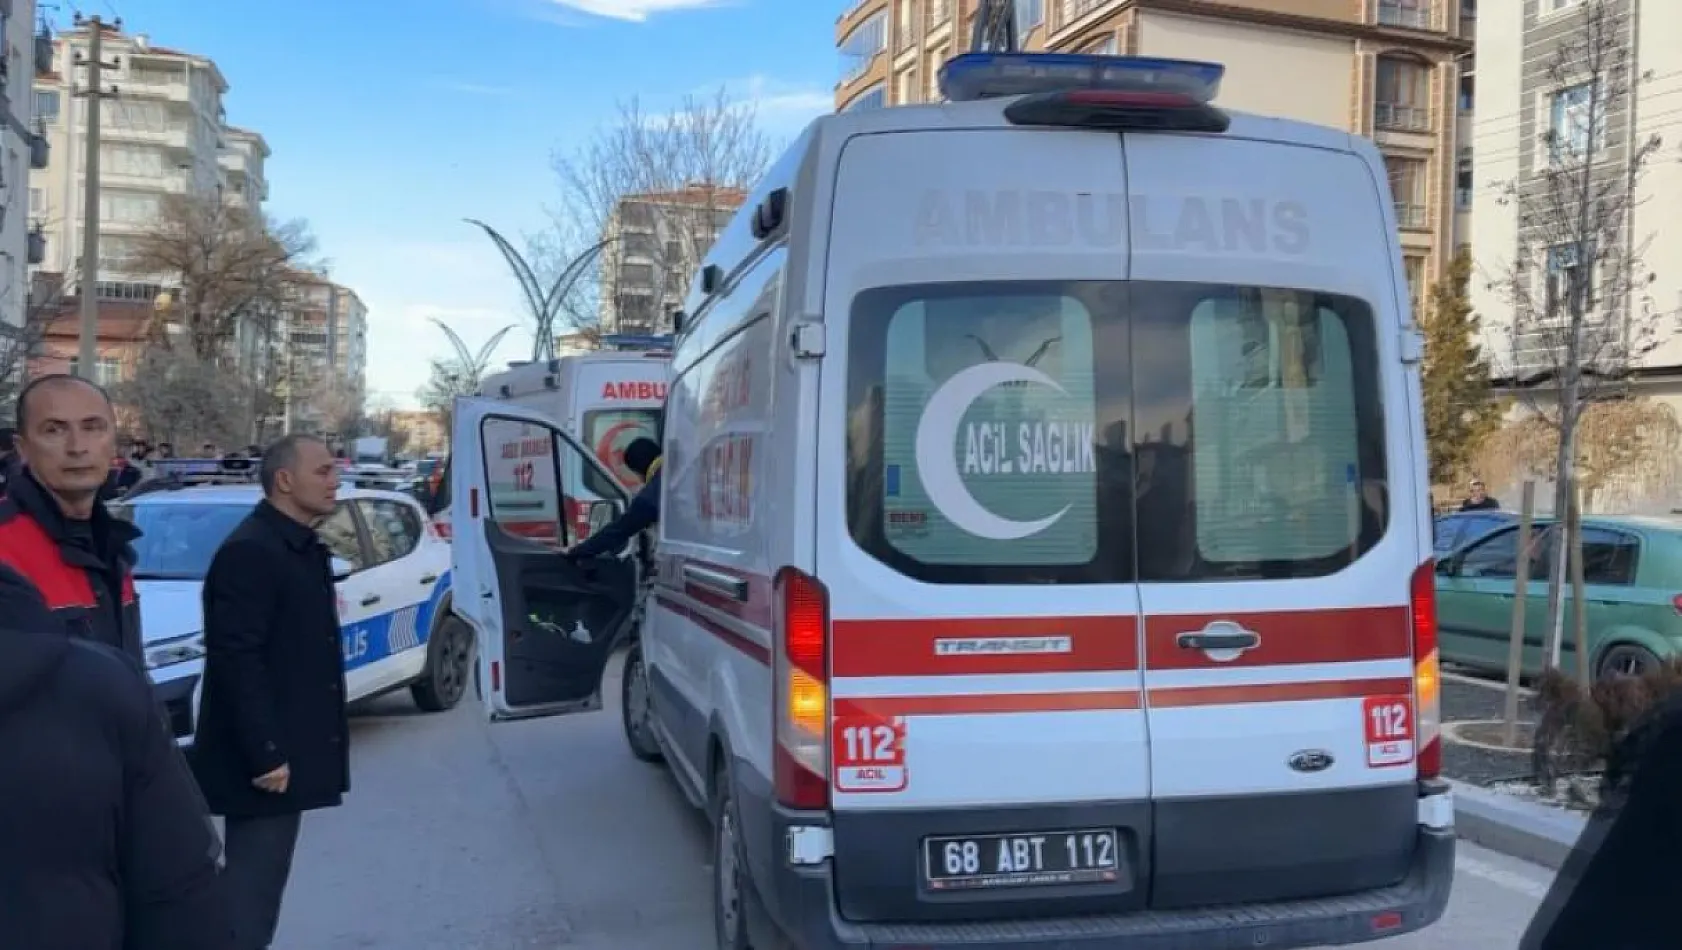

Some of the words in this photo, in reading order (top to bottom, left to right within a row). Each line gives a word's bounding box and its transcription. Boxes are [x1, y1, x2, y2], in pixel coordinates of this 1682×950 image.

[914, 189, 1311, 255] AMBULANS
[602, 380, 667, 400] AMBU
[342, 624, 368, 661] LİS
[1371, 704, 1408, 737] 112
[842, 726, 896, 761] 112
[944, 841, 980, 875] 68
[998, 837, 1046, 872] ABT
[1065, 834, 1114, 868] 112
